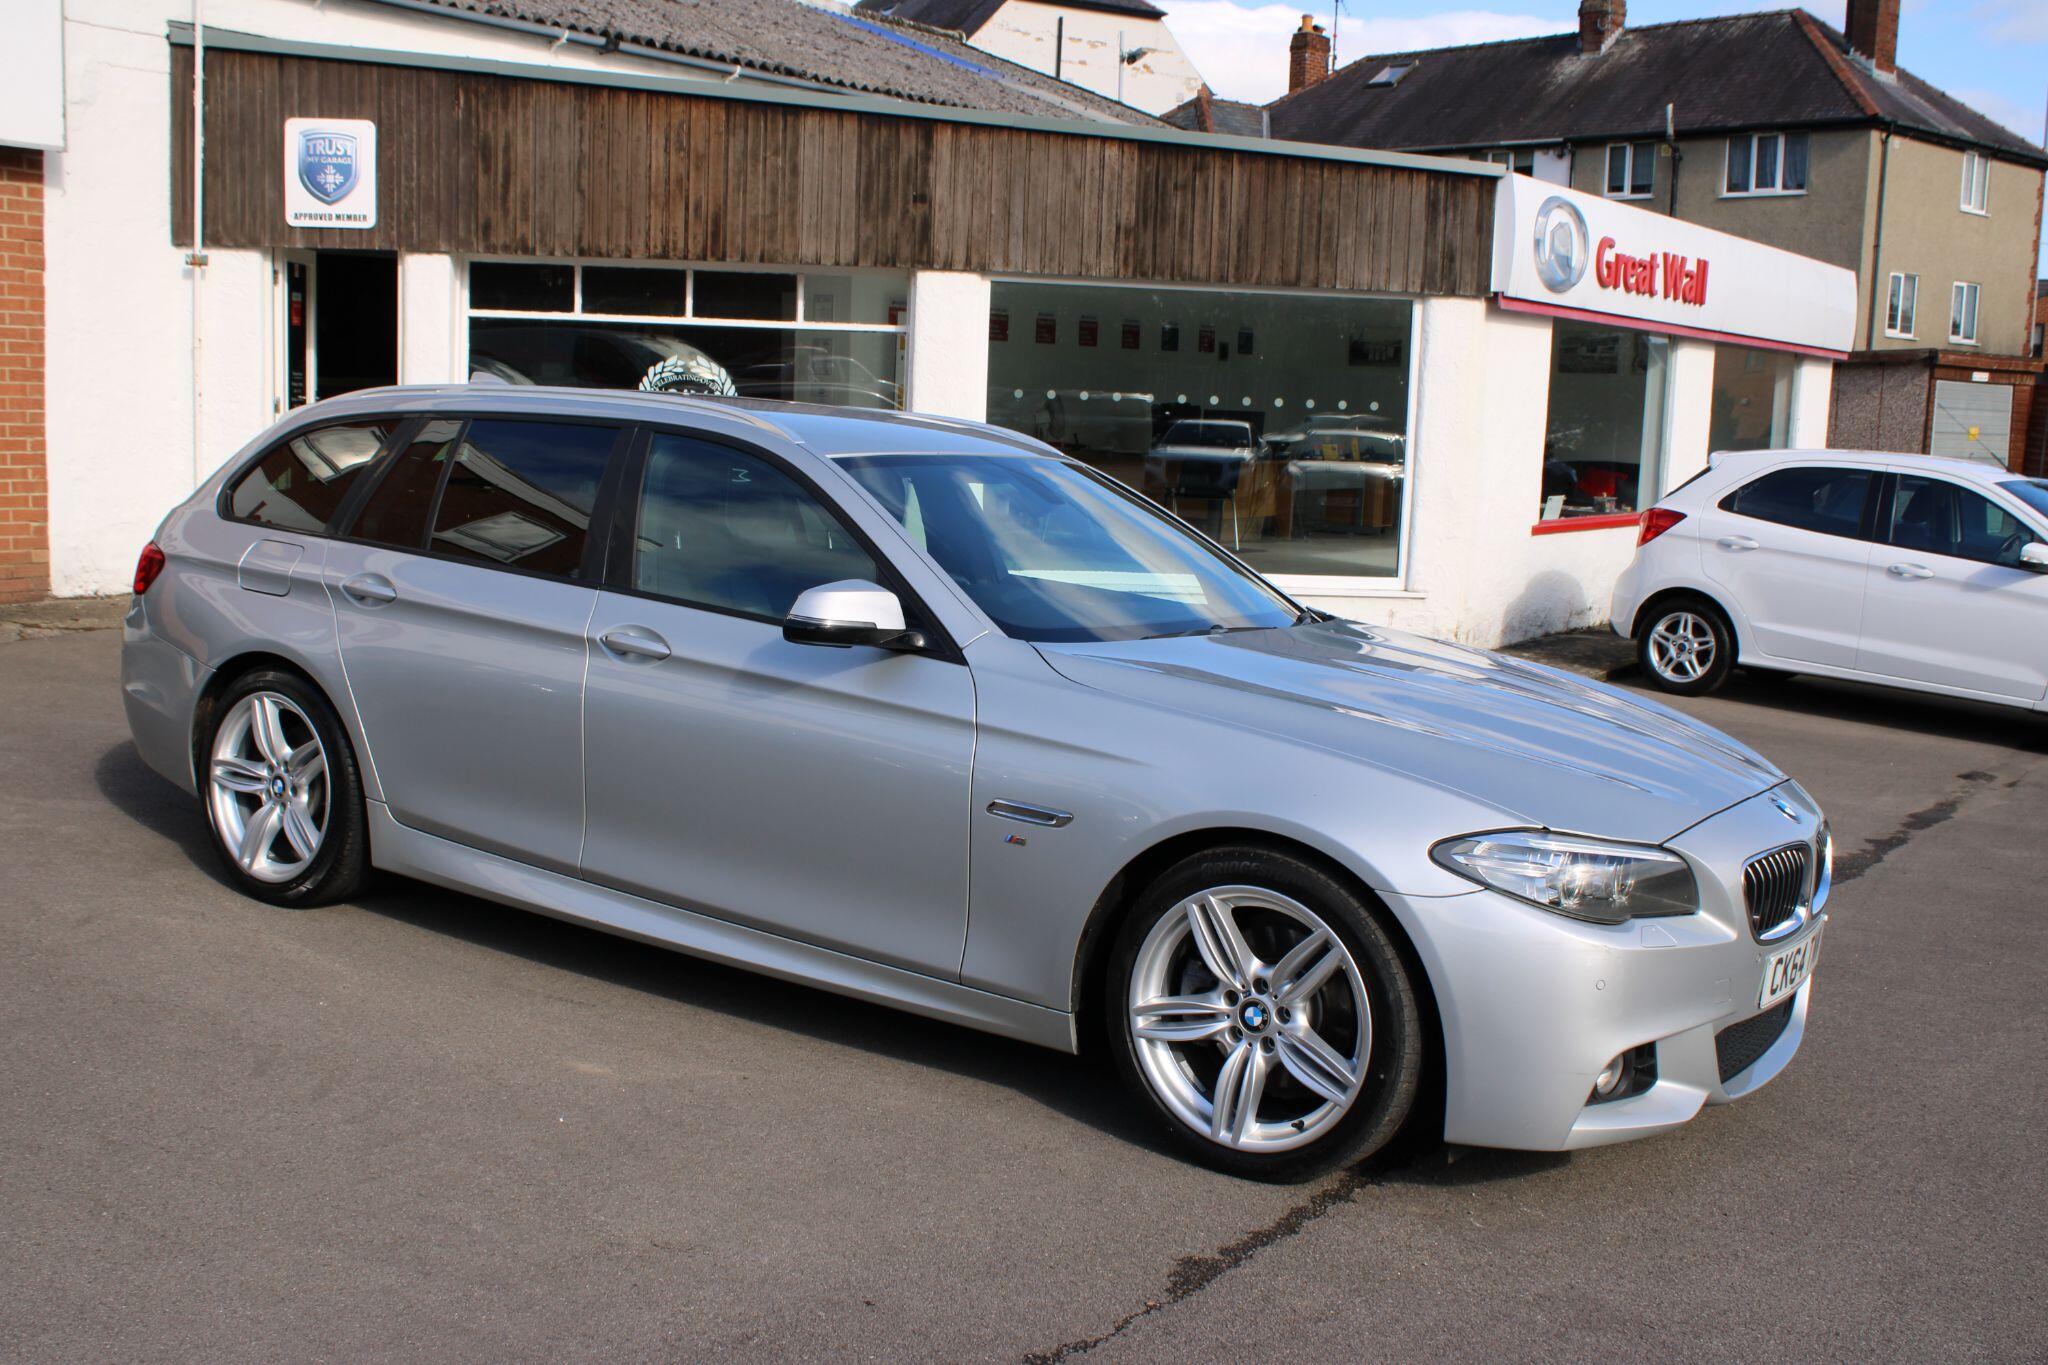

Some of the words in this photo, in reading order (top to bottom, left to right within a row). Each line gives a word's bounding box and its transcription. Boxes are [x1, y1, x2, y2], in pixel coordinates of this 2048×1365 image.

[306, 137, 353, 156] TRUST
[305, 155, 319, 163] MY
[320, 156, 353, 165] GARAGE
[293, 212, 333, 222] APPROVED
[335, 213, 368, 223] MEMBER
[1595, 235, 1660, 298] Great
[1662, 251, 1710, 307] Wall
[653, 373, 701, 392] CELEBRATING
[1769, 941, 1808, 996] CK64
